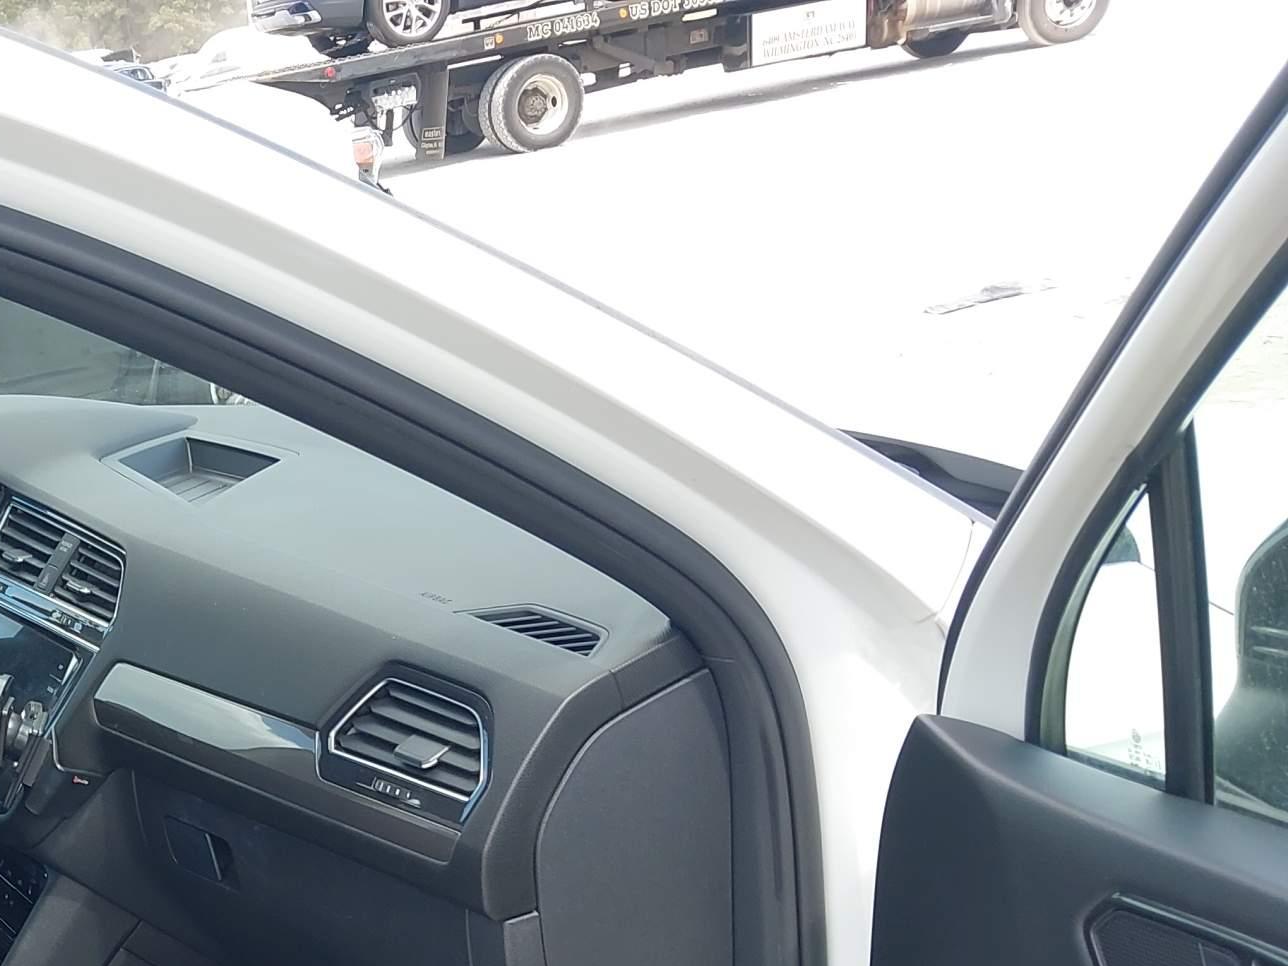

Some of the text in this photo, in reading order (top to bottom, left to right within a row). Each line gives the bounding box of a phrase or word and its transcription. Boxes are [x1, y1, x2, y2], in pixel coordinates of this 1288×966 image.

[629, 2, 649, 20] US
[650, 0, 680, 16] DOT
[527, 11, 600, 42] MC 041634
